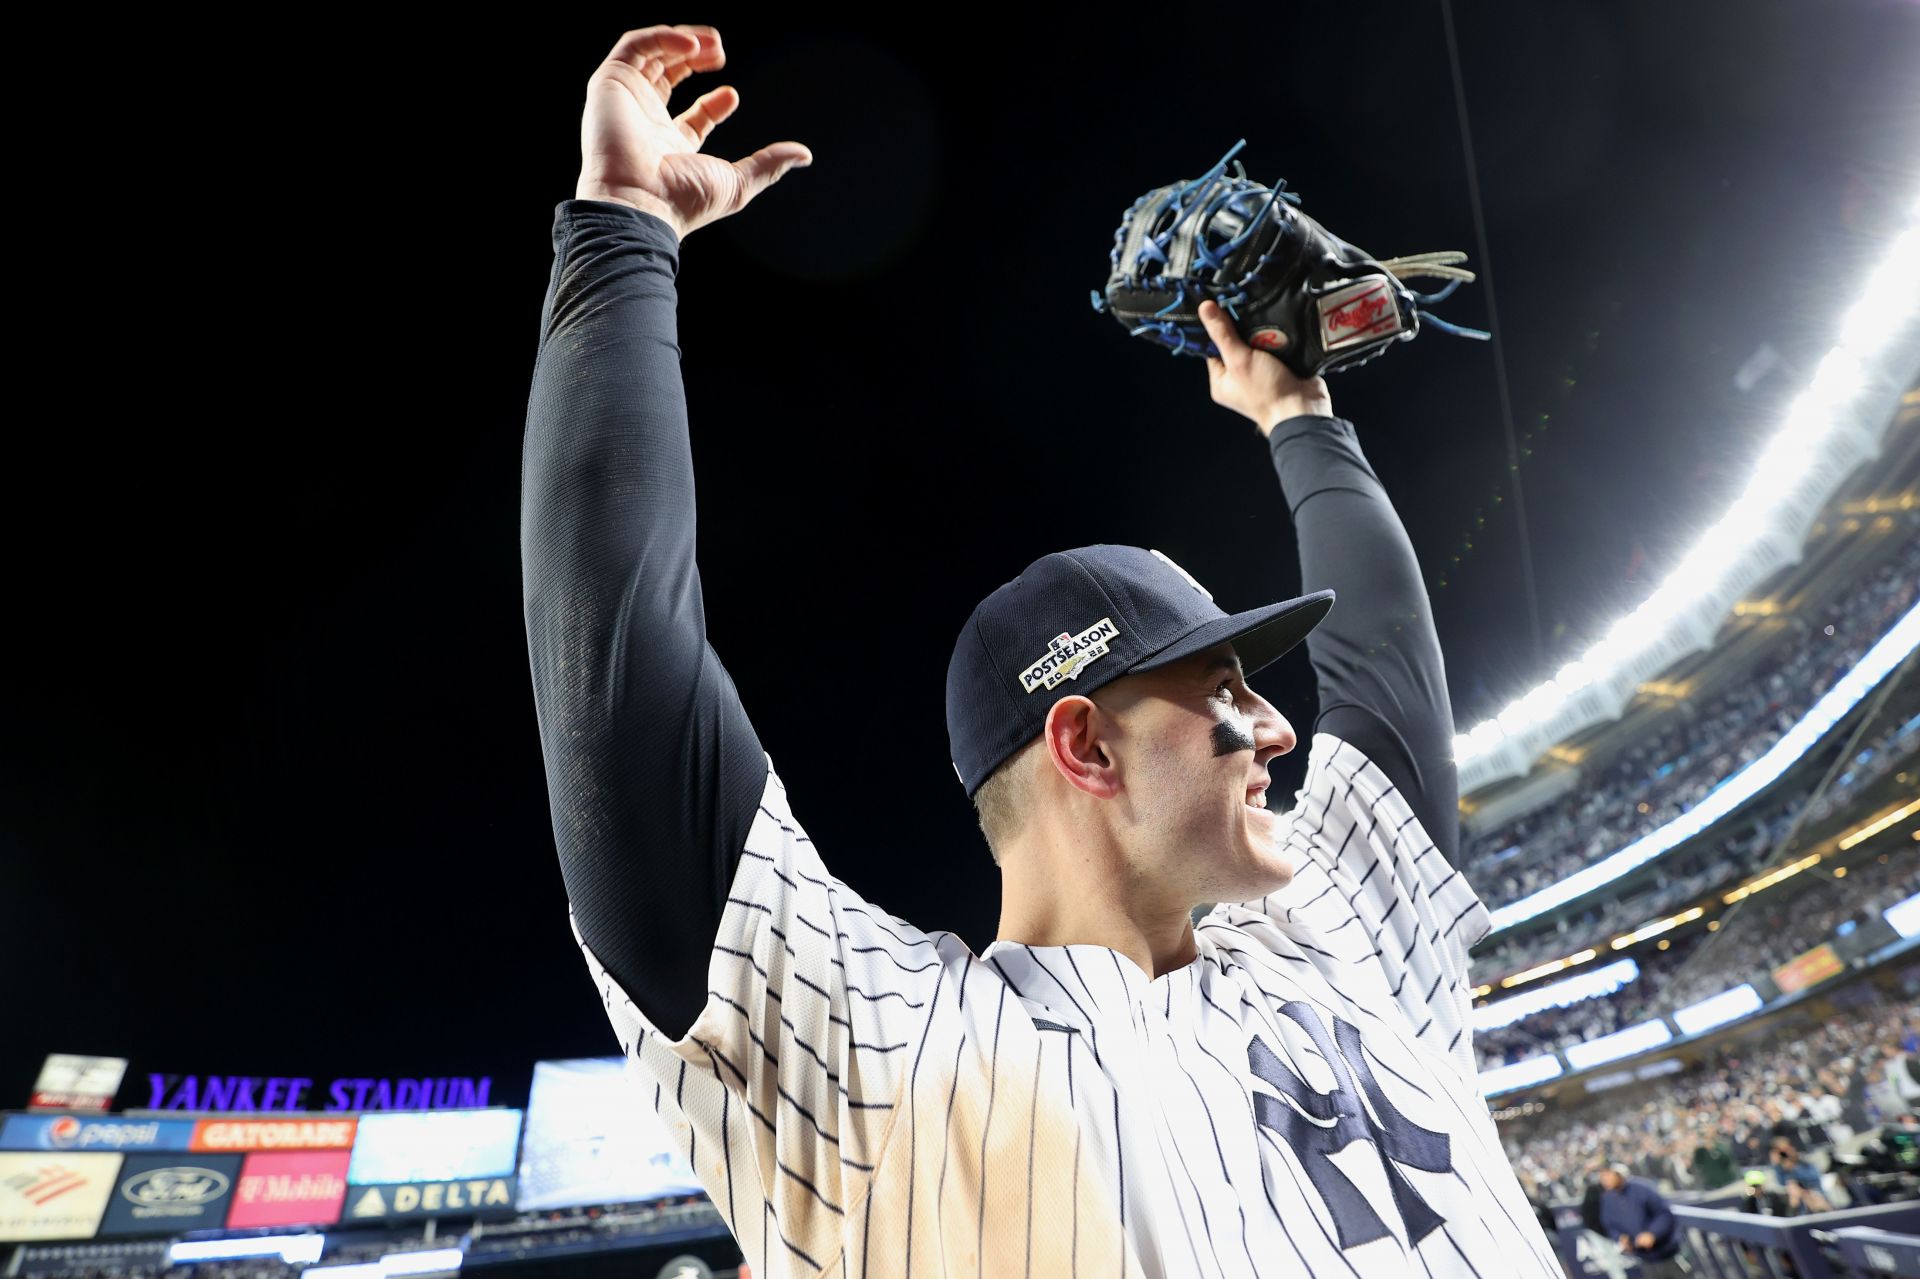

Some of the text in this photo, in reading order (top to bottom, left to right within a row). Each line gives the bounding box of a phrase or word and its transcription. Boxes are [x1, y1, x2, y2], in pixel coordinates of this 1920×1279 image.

[1023, 623, 1113, 687] POSTSEASON
[148, 1073, 493, 1112] YANKEE STADIUM
[79, 1121, 160, 1148] pepsi
[202, 1122, 351, 1147] GATORADE
[393, 1180, 511, 1212] DELTA
